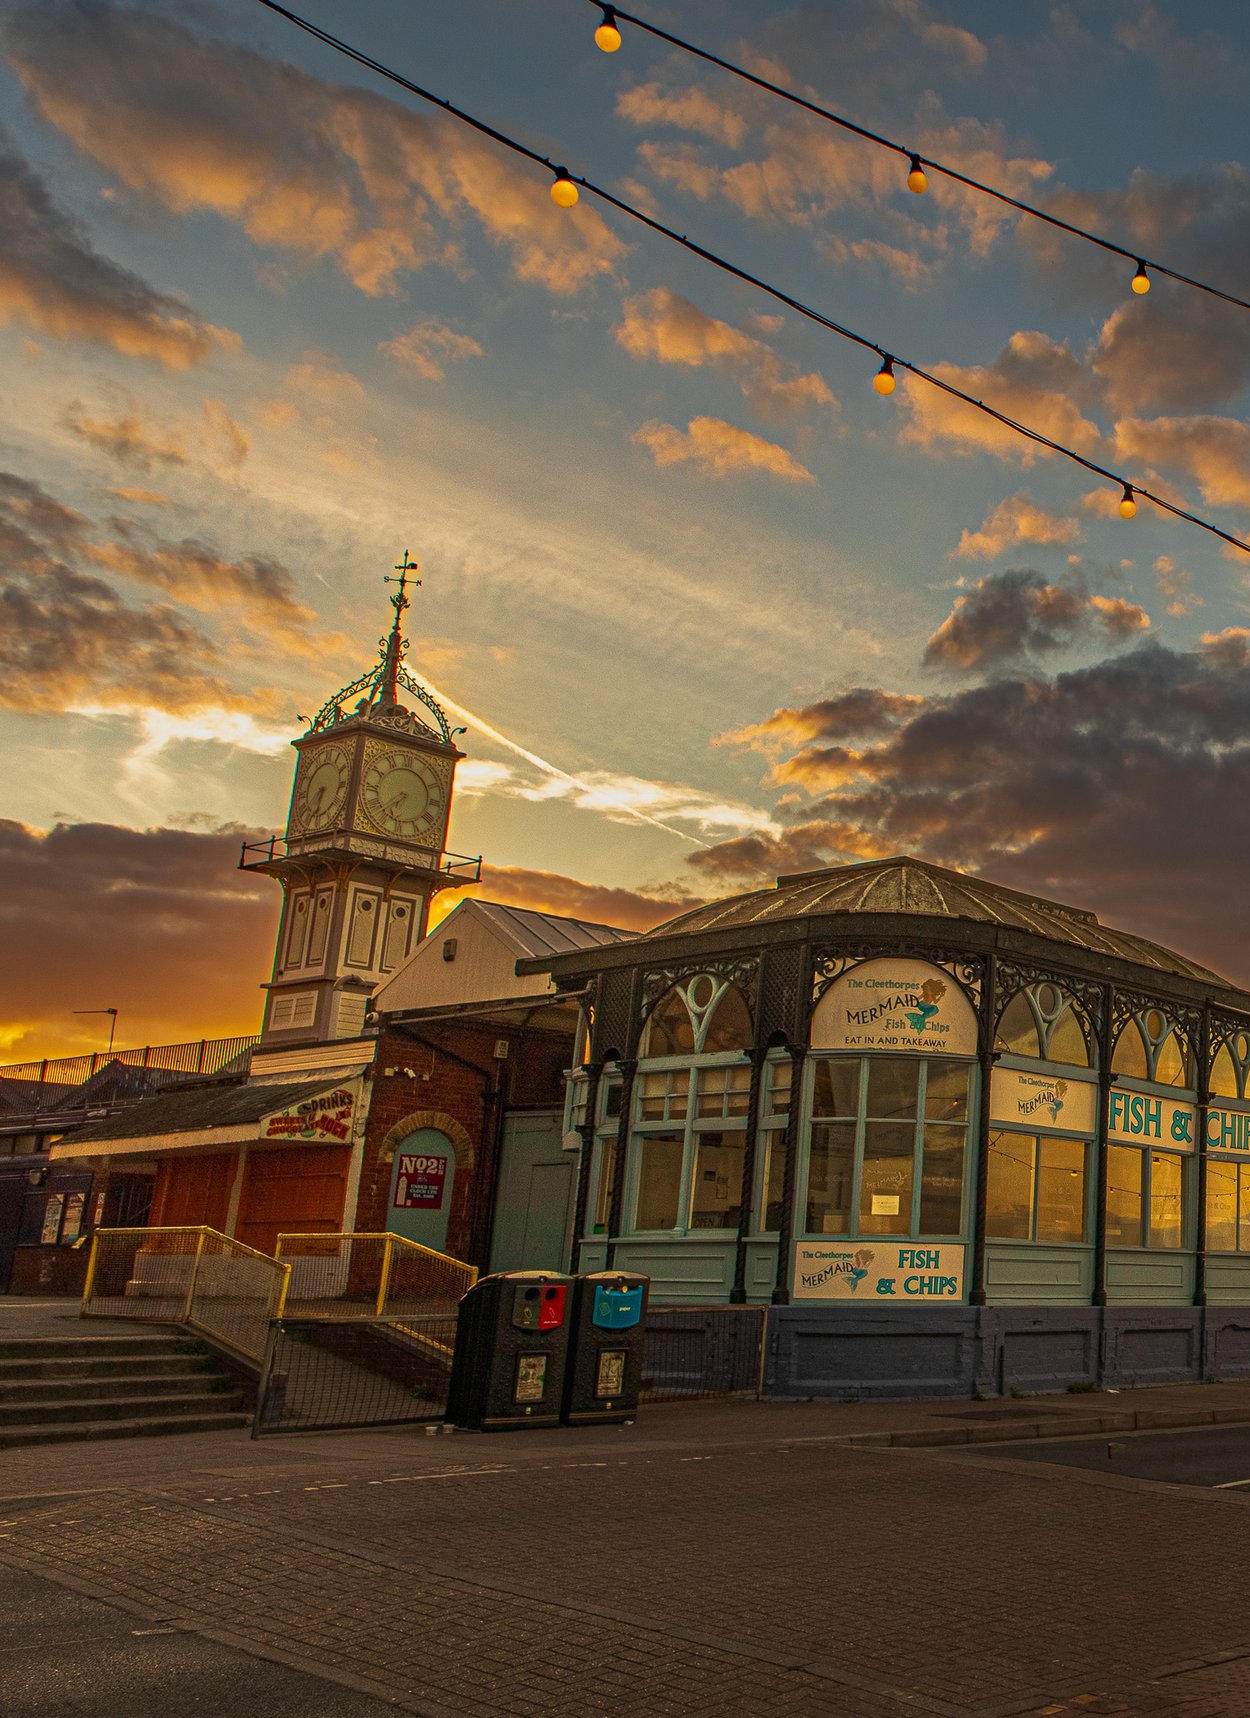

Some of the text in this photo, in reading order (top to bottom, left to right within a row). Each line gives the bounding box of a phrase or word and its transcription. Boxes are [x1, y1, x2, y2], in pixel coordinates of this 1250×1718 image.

[846, 978, 920, 990] The Cleethorpes
[846, 993, 920, 1025] MERMAID
[885, 1018, 906, 1030] Fish
[925, 1020, 950, 1033] Chips
[845, 1036, 947, 1048] EAT IN AND TAKEAWAY
[1018, 1075, 1027, 1085] The
[311, 1094, 353, 1111] DRINKS
[1018, 1090, 1056, 1113] MERMAID
[1109, 1091, 1162, 1138] FISH
[1170, 1109, 1192, 1143] &
[802, 1250, 853, 1260] The Cleethorpes
[898, 1249, 940, 1269] FISH
[802, 1262, 853, 1287] MERMAID
[875, 1276, 957, 1295] & CHIPS
